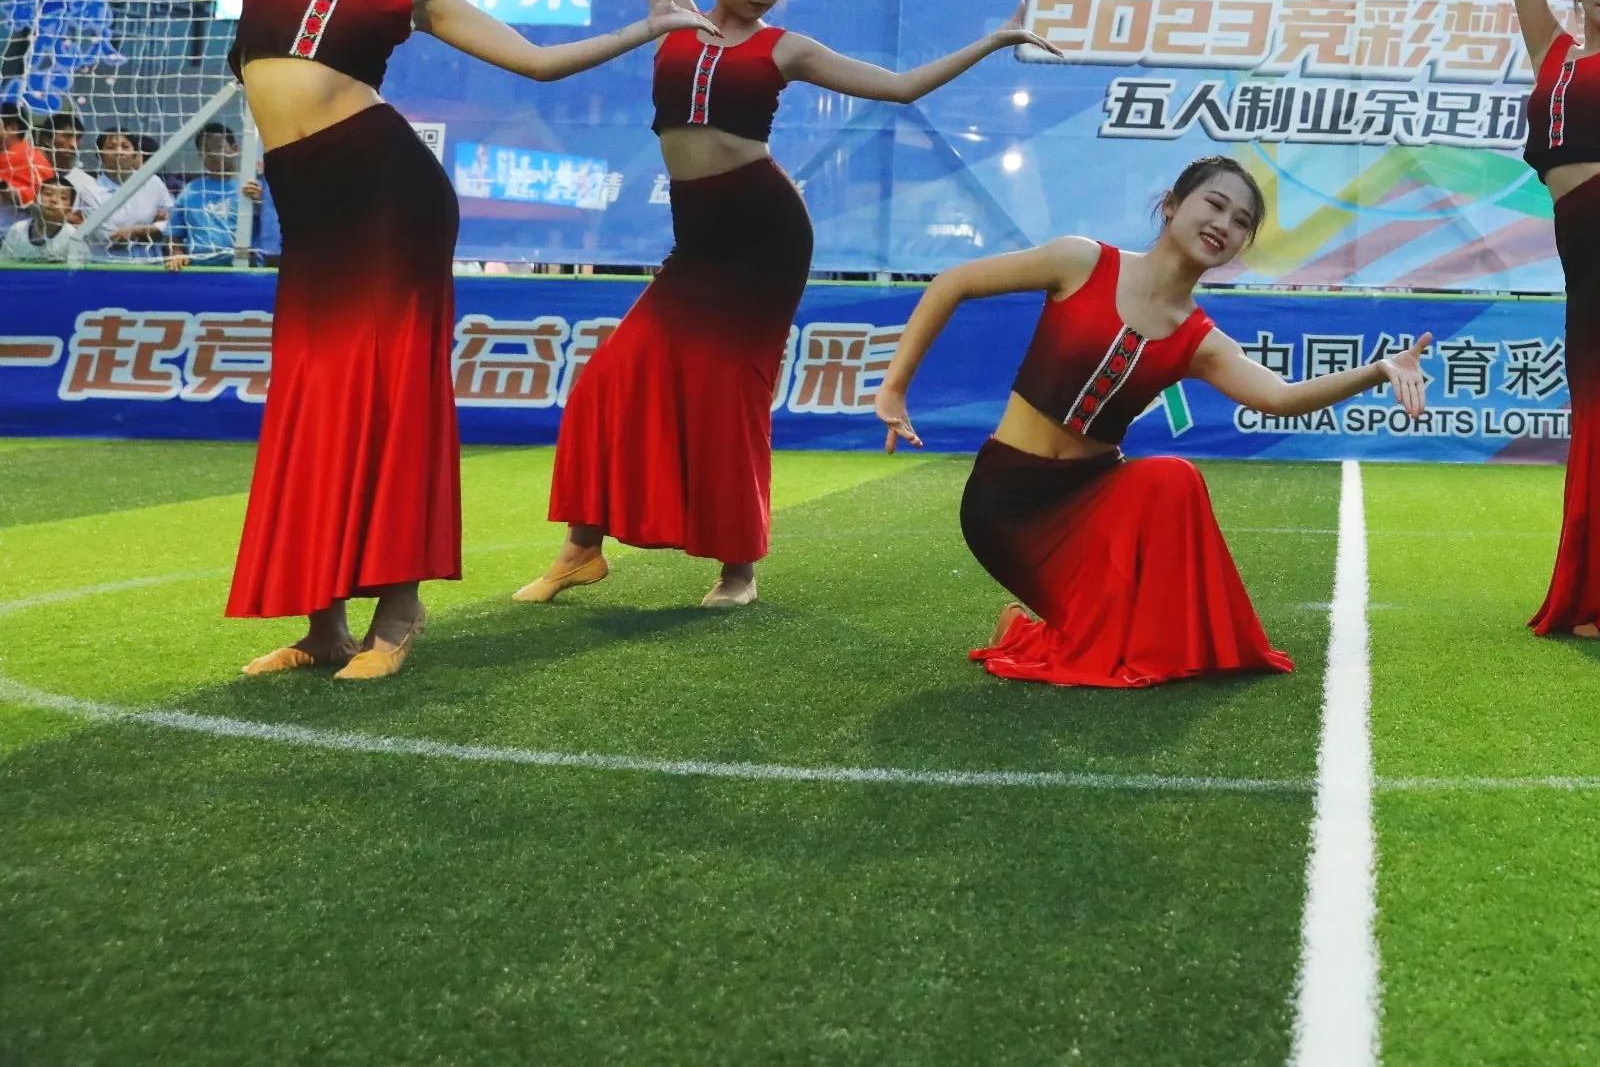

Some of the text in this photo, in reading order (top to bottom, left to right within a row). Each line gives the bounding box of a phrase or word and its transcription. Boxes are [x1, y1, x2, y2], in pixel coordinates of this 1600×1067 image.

[1237, 406, 1571, 436] CHINA SPORTS LOTT
